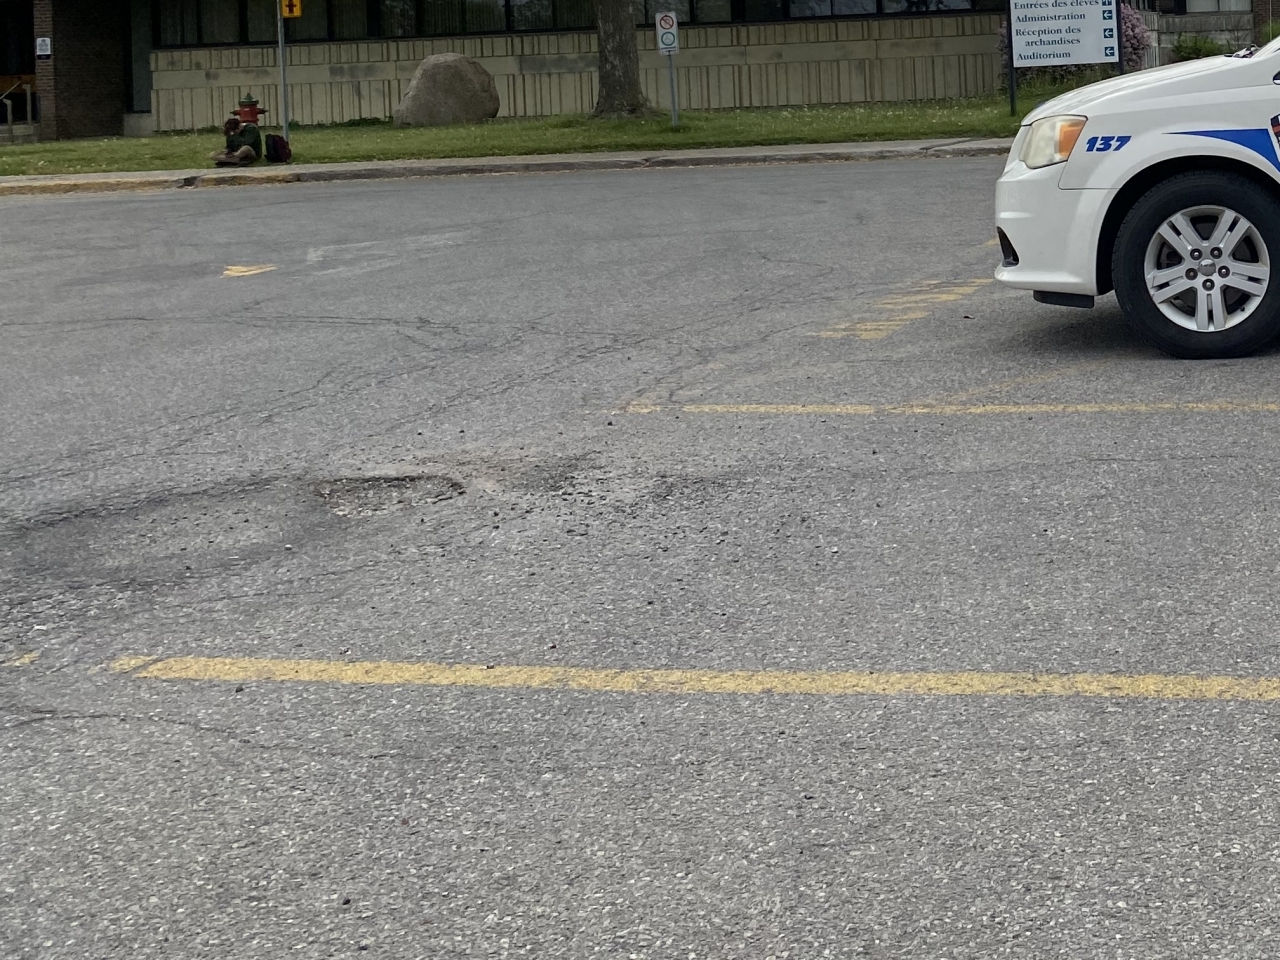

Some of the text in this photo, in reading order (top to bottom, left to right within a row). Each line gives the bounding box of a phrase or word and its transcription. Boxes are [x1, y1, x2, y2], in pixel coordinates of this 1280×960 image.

[1014, 0, 1049, 10] Entrées
[1052, 0, 1068, 8] des
[1015, 13, 1086, 23] Administration
[1015, 26, 1081, 37] Réception des
[1025, 37, 1080, 47] archandises
[1017, 52, 1071, 61] Auditorium
[1086, 135, 1132, 152] 137
